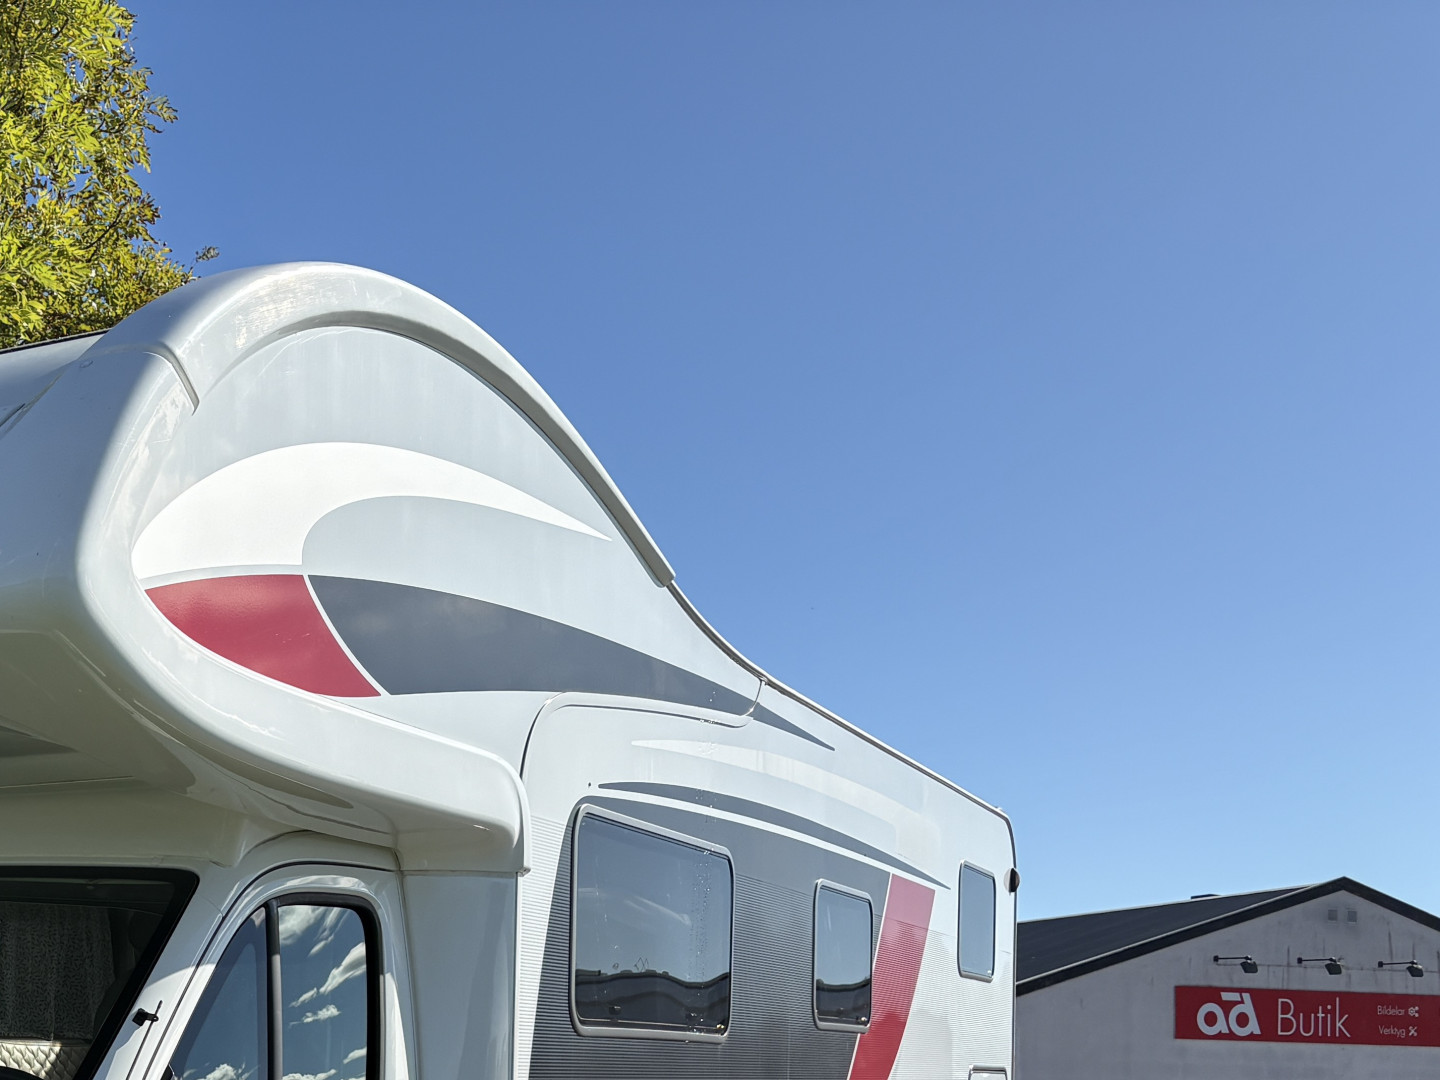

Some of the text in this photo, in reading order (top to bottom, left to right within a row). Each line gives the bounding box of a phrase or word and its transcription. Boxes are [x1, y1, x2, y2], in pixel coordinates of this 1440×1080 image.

[1377, 1005, 1405, 1016] Bildelar
[1277, 997, 1351, 1038] Butik
[1378, 1025, 1406, 1038] Verktyg
